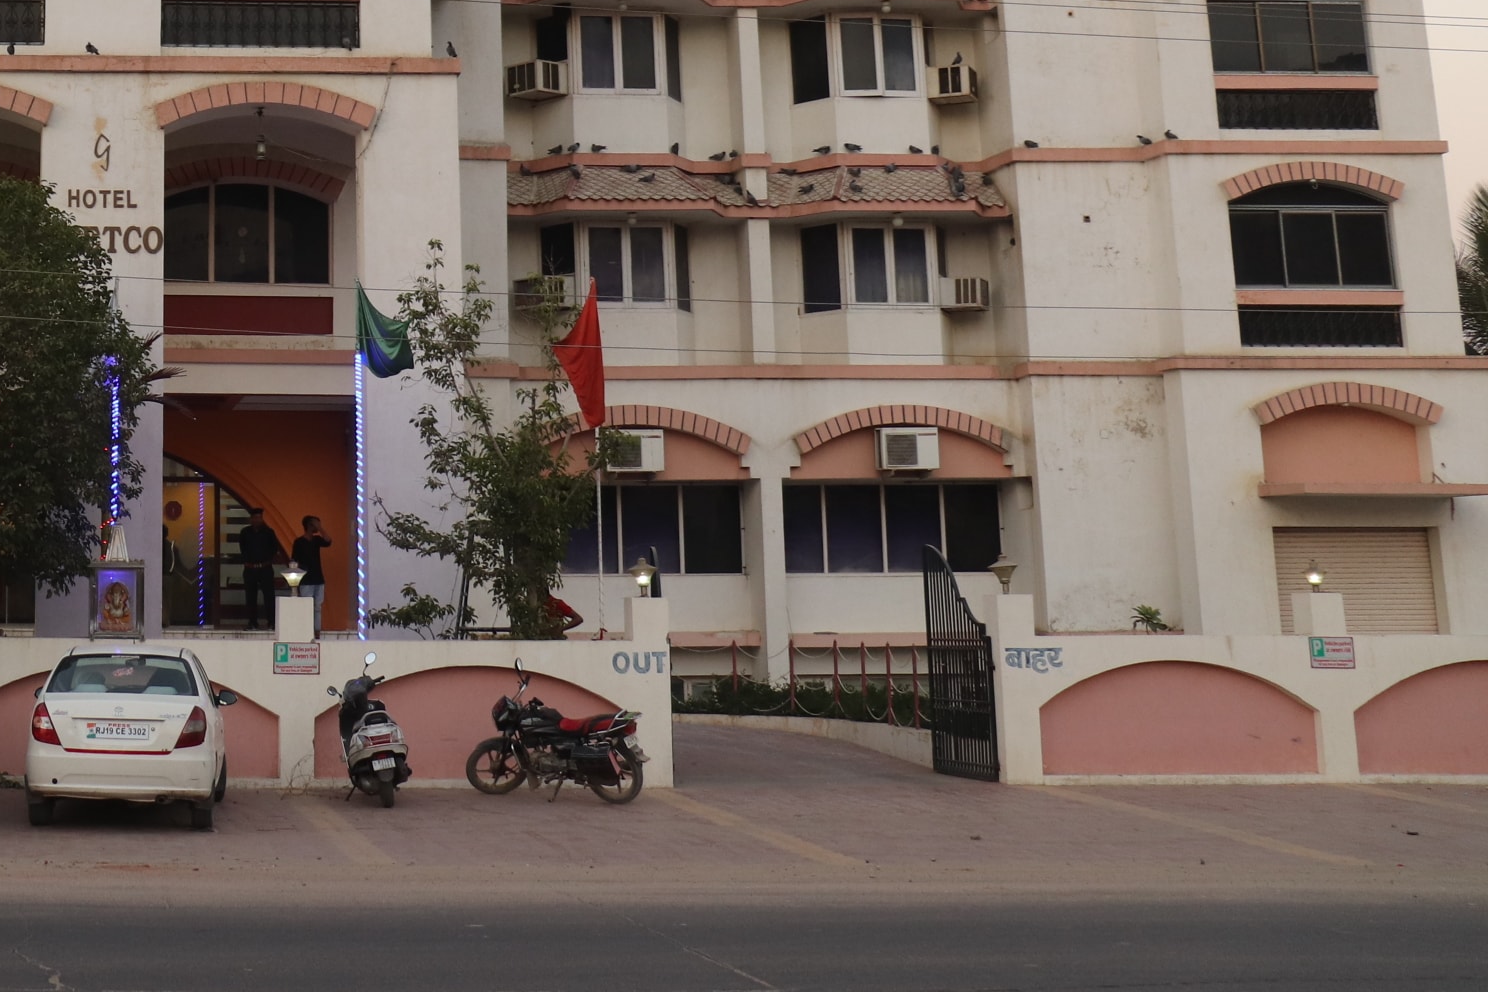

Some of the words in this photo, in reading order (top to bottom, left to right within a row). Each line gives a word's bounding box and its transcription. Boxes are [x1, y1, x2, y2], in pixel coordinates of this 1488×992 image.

[67, 189, 138, 209] HOTEL
[277, 645, 286, 662] P
[612, 651, 667, 674] OUT
[1005, 648, 1063, 674] बाहर
[115, 727, 126, 735] CE
